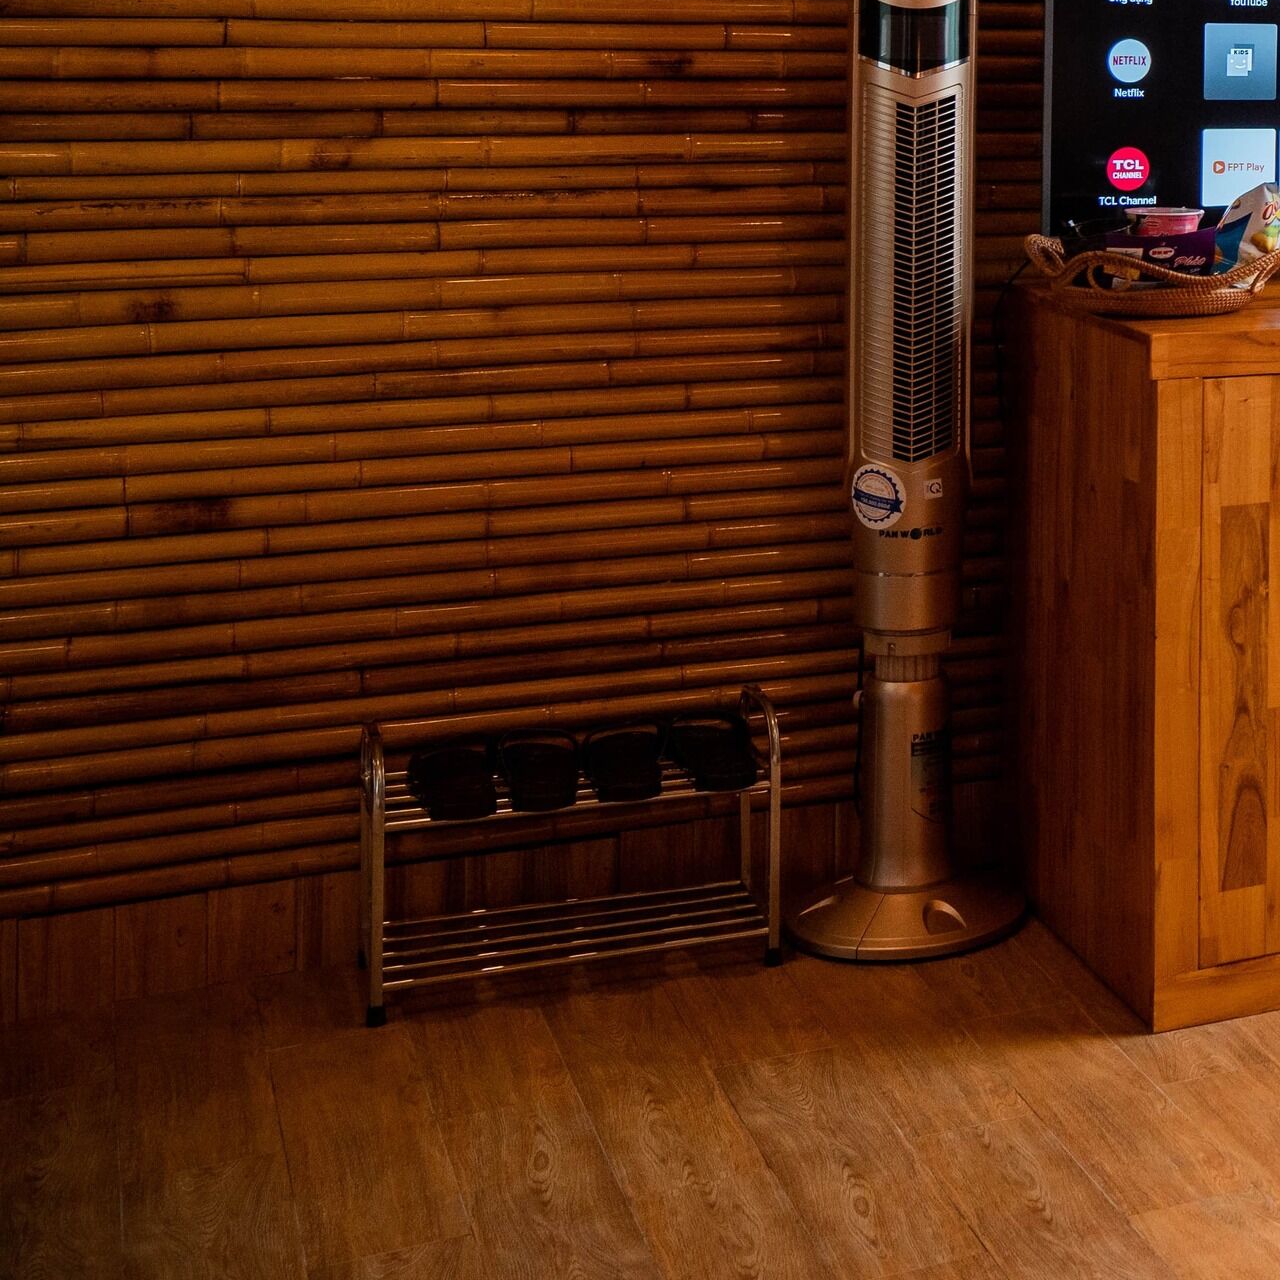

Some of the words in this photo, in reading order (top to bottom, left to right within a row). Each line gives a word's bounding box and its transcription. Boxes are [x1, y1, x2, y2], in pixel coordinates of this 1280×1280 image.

[1113, 55, 1147, 66] NETFLIX
[1114, 88, 1145, 98] Netflix
[1113, 159, 1144, 170] TCL
[1227, 163, 1244, 171] FPT
[1246, 163, 1265, 172] Play
[1113, 171, 1143, 179] CHANNEL
[1099, 196, 1118, 206] TCL
[1119, 195, 1157, 205] Channel
